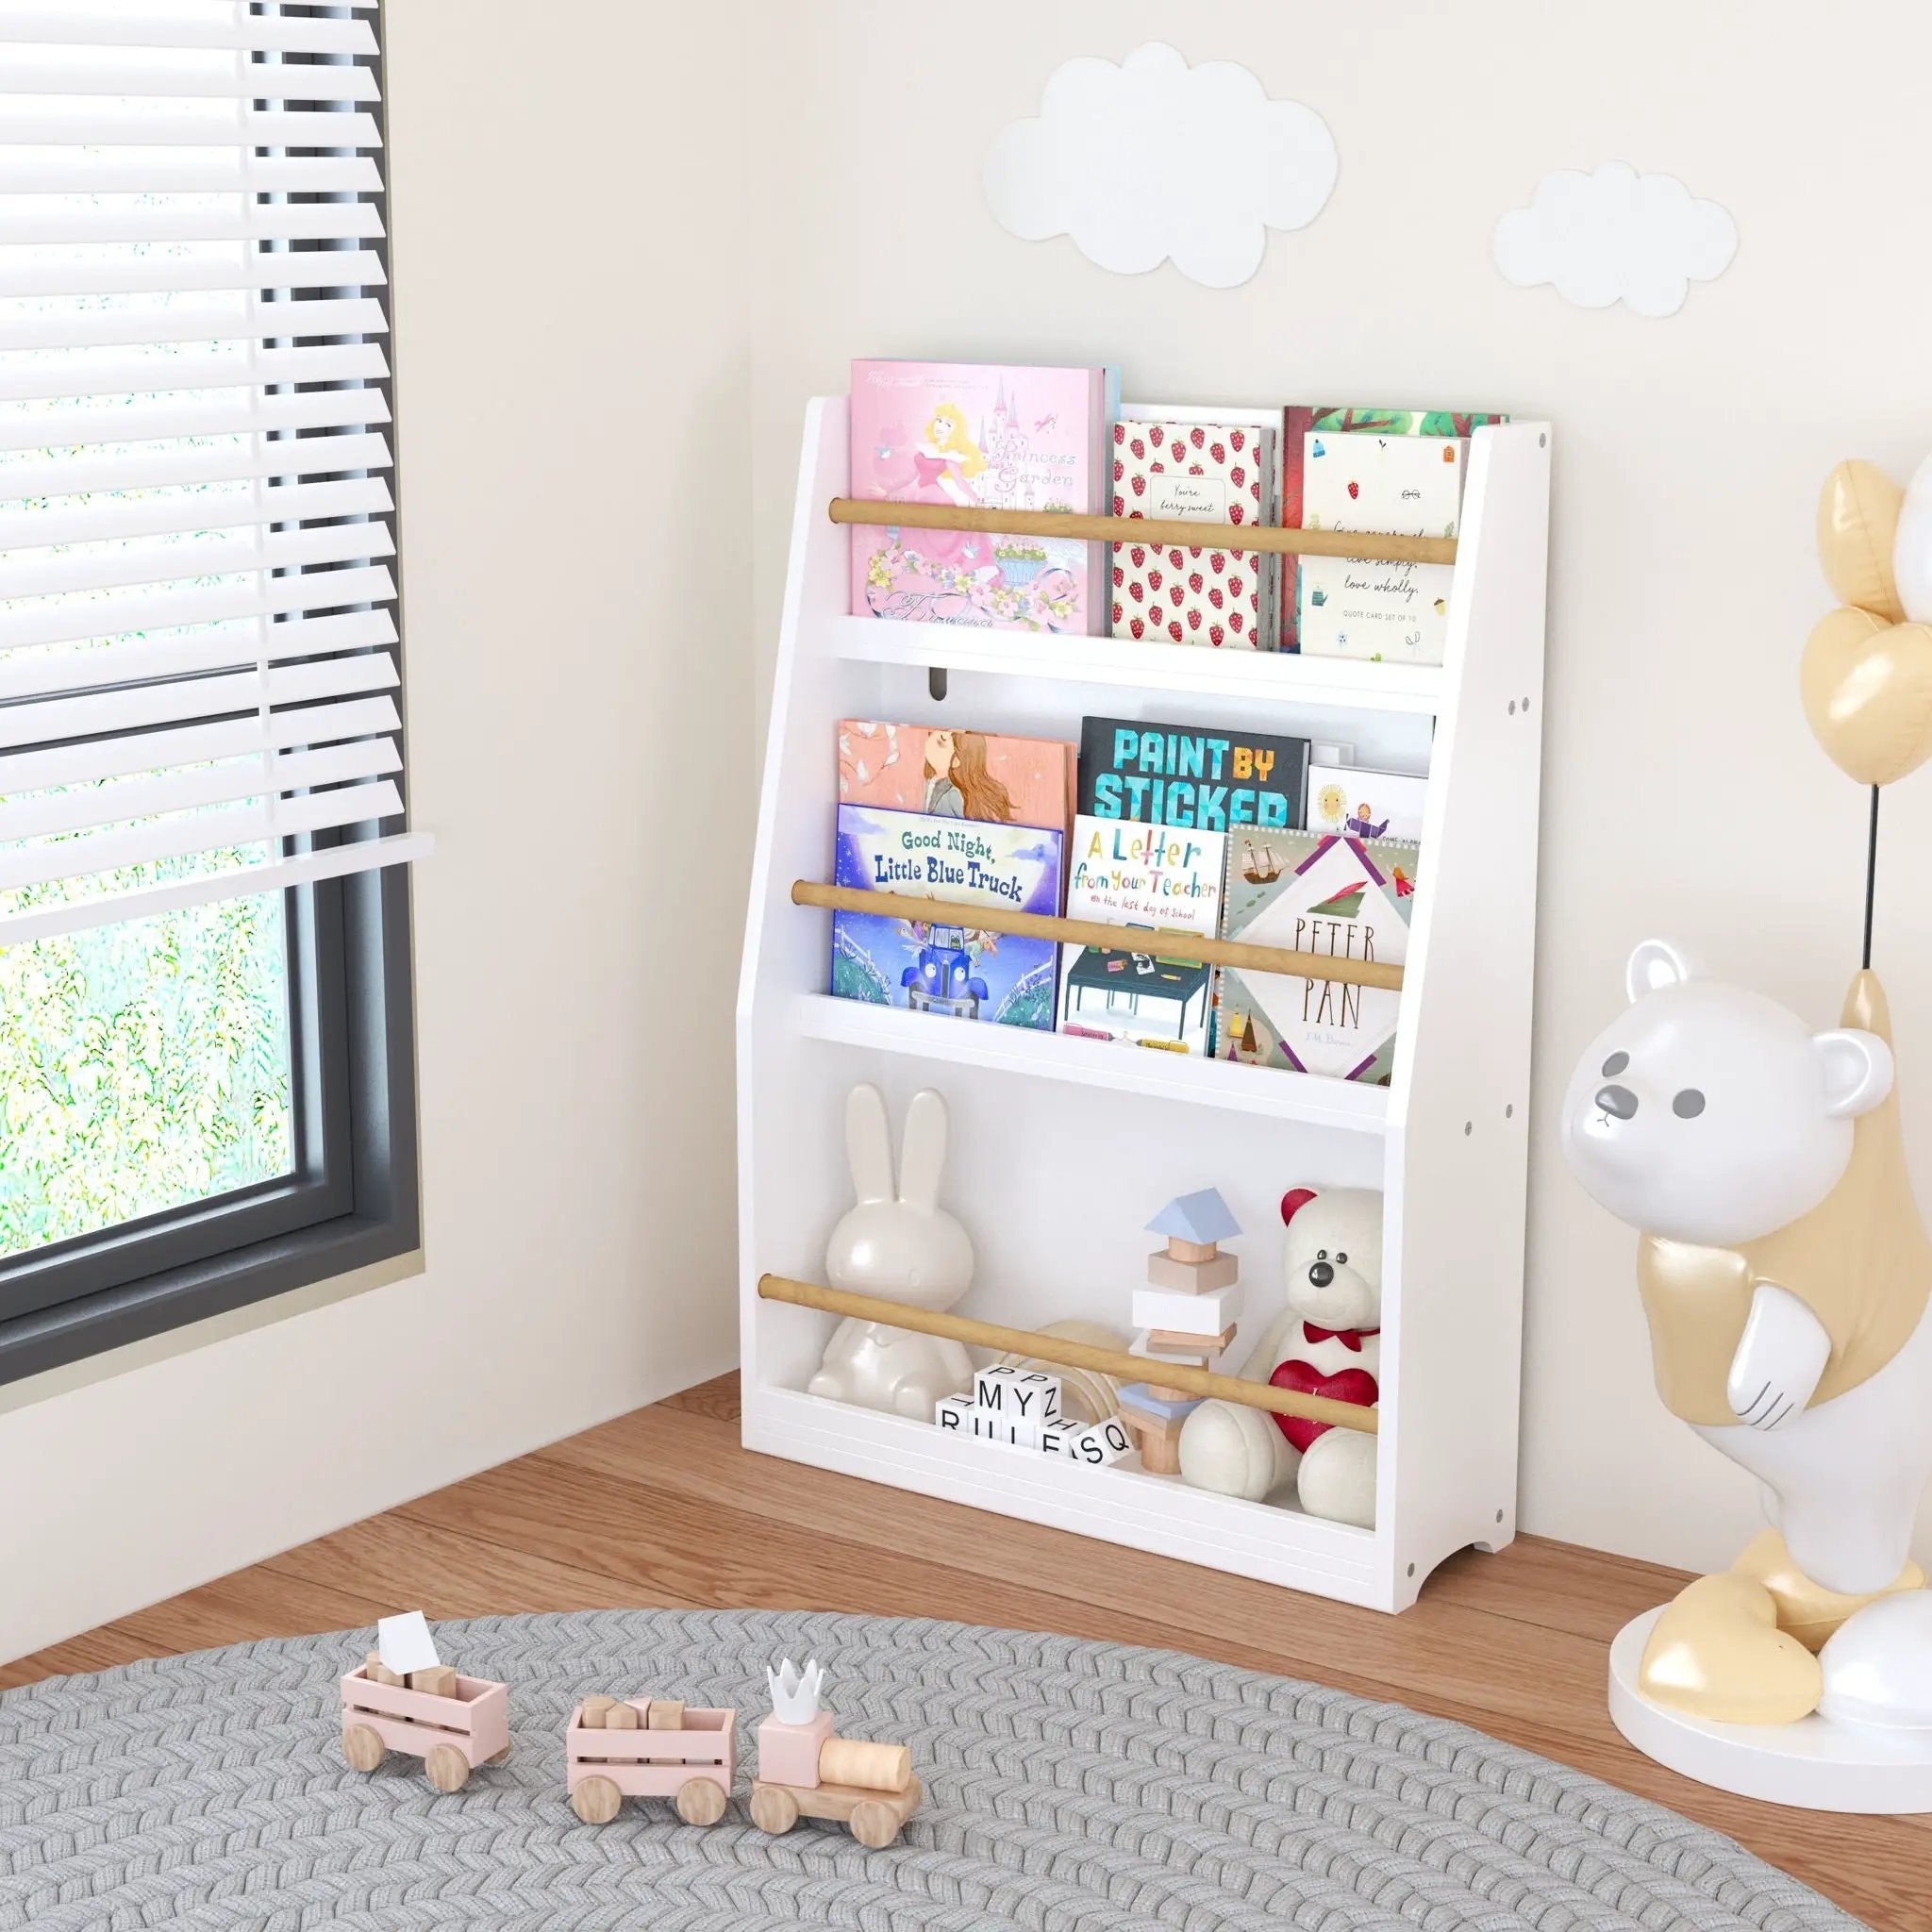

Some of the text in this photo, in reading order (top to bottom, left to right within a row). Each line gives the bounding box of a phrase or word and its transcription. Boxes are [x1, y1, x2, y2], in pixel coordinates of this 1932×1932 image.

[1344, 574, 1419, 603] love wholly.
[1343, 609, 1364, 618] QUOTE
[1113, 728, 1274, 782] PAINT BY
[1094, 773, 1289, 833] STICKER
[901, 830, 996, 864] Good Night,
[1088, 828, 1202, 868] A Letter
[874, 854, 1023, 903] Little Blue Truck
[1074, 862, 1108, 890] from
[1149, 870, 1216, 898] Teacher
[1103, 897, 1117, 908] the
[1296, 918, 1374, 961] PETER
[1303, 978, 1361, 1029] PAN
[979, 1380, 1033, 1416] MY
